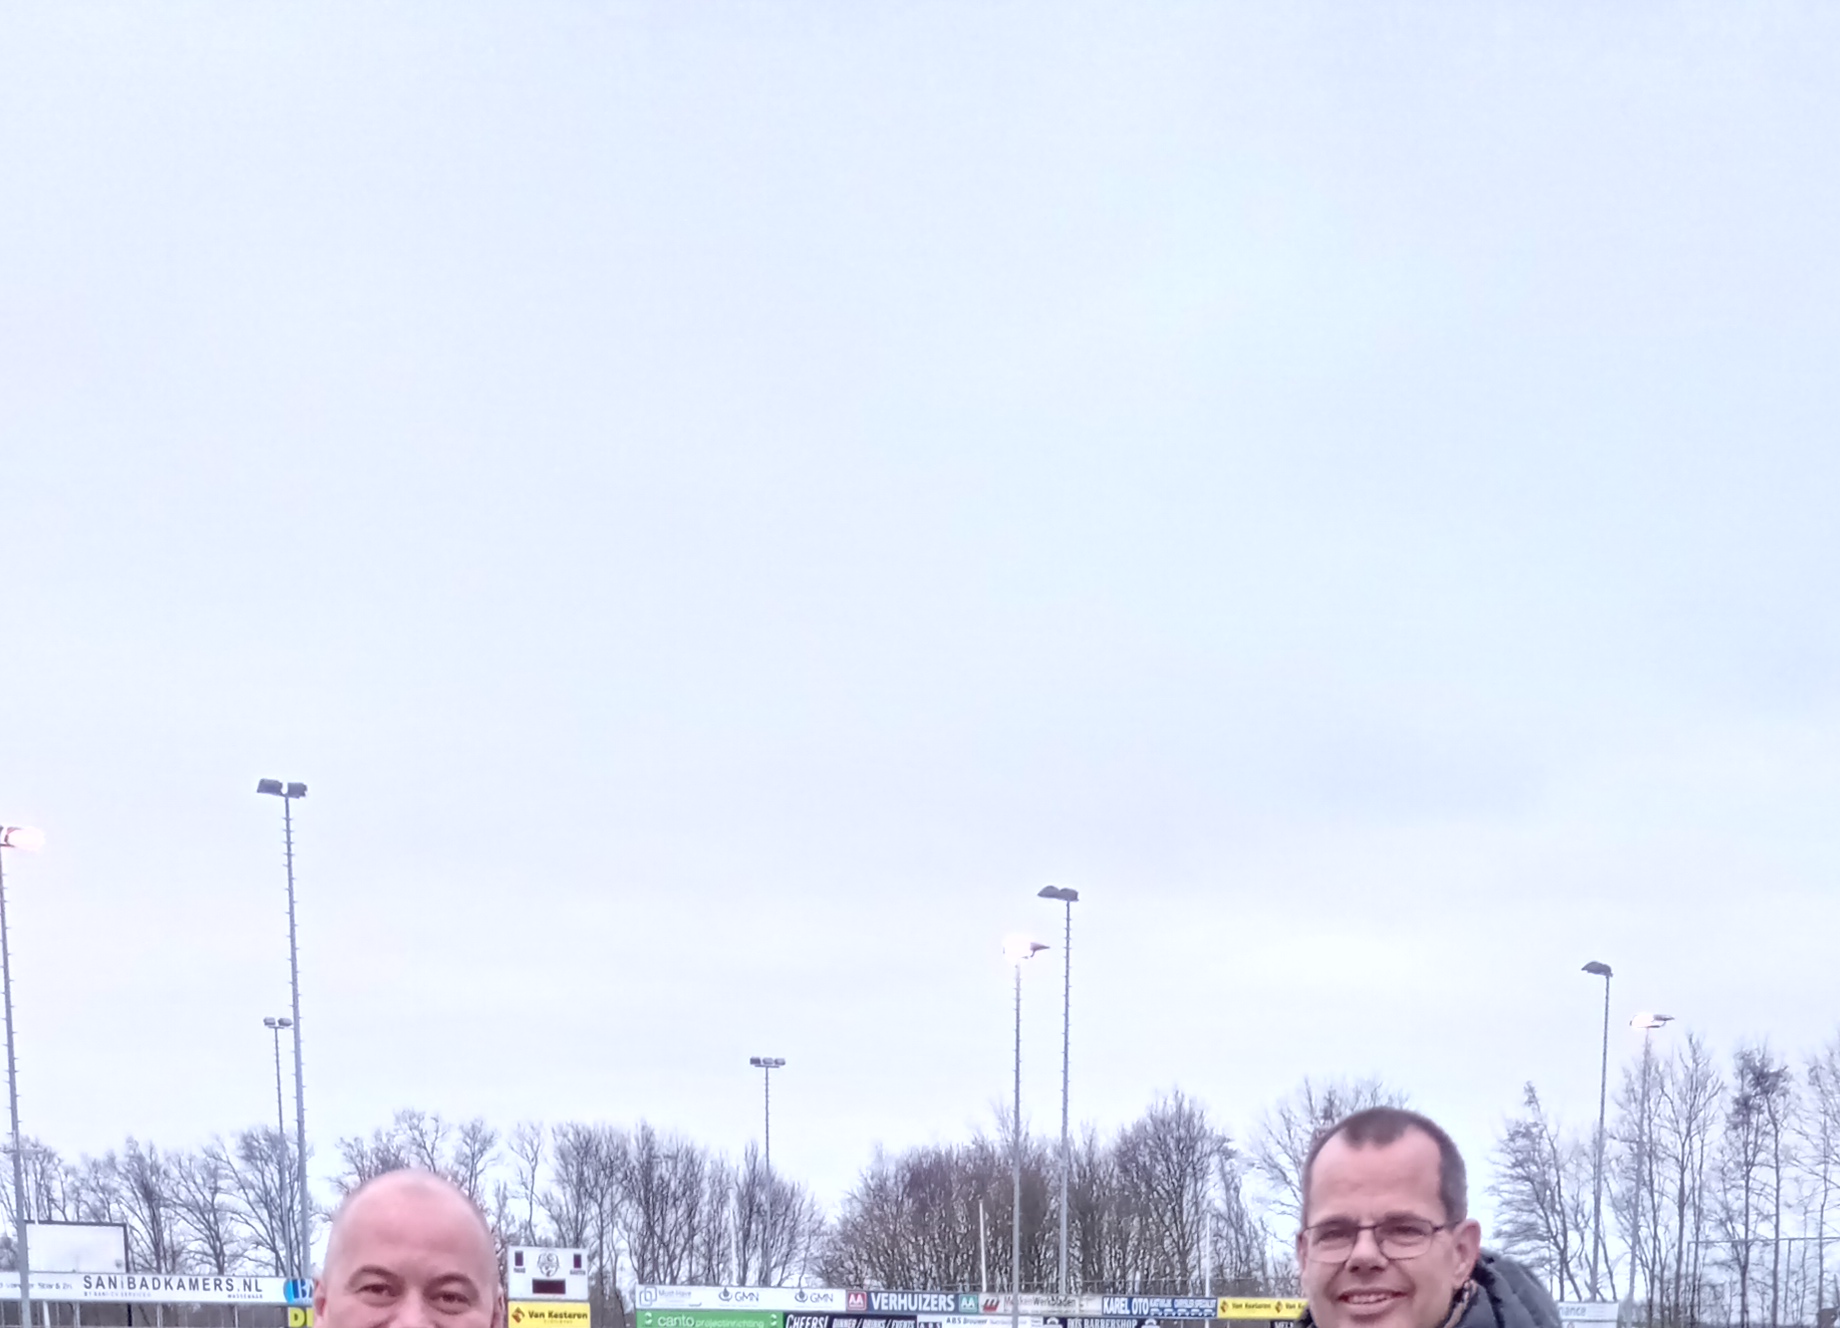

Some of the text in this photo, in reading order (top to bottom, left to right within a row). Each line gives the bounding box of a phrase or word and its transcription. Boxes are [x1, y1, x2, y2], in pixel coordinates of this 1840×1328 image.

[871, 1293, 955, 1311] VERHUIZERS
[1103, 1298, 1129, 1315] KAREL
[528, 1310, 545, 1319] Van
[657, 1314, 695, 1328] canto
